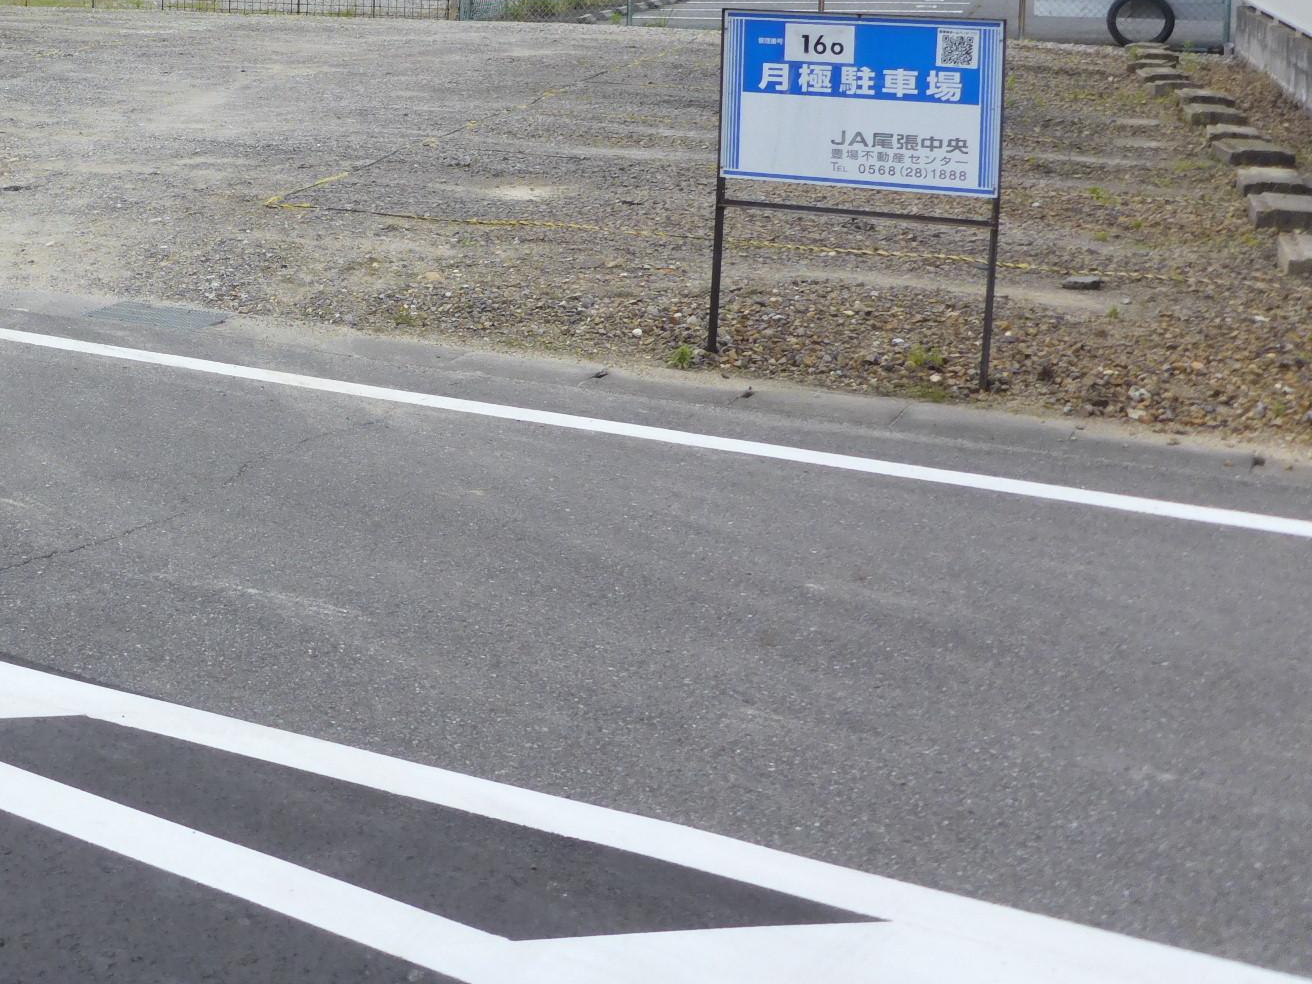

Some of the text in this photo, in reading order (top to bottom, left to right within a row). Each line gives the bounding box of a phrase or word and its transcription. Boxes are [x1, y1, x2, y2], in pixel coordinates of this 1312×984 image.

[758, 62, 963, 102] 月極駐車場
[830, 130, 969, 155] JA尾張中央
[830, 148, 969, 167] 豊場不動産センター
